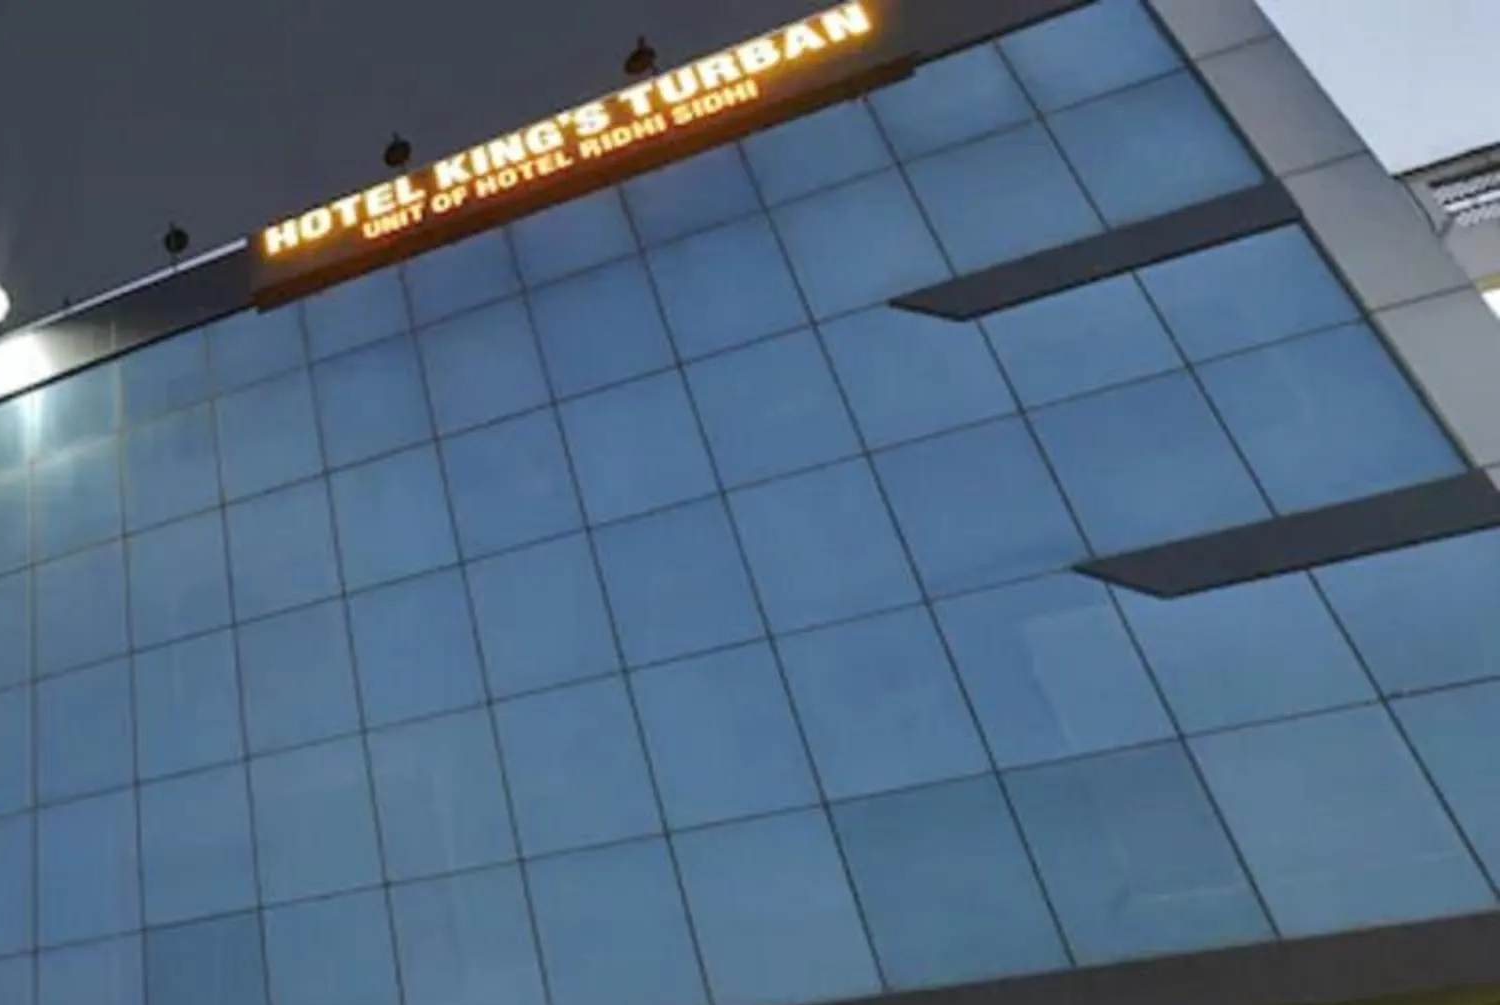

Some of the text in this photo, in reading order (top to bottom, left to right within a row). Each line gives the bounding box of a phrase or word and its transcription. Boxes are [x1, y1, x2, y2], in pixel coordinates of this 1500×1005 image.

[263, 1, 873, 256] HOTEL KING'S TURBAN
[363, 80, 760, 241] UNIT OF HOTEL RIDHI SIDHI
